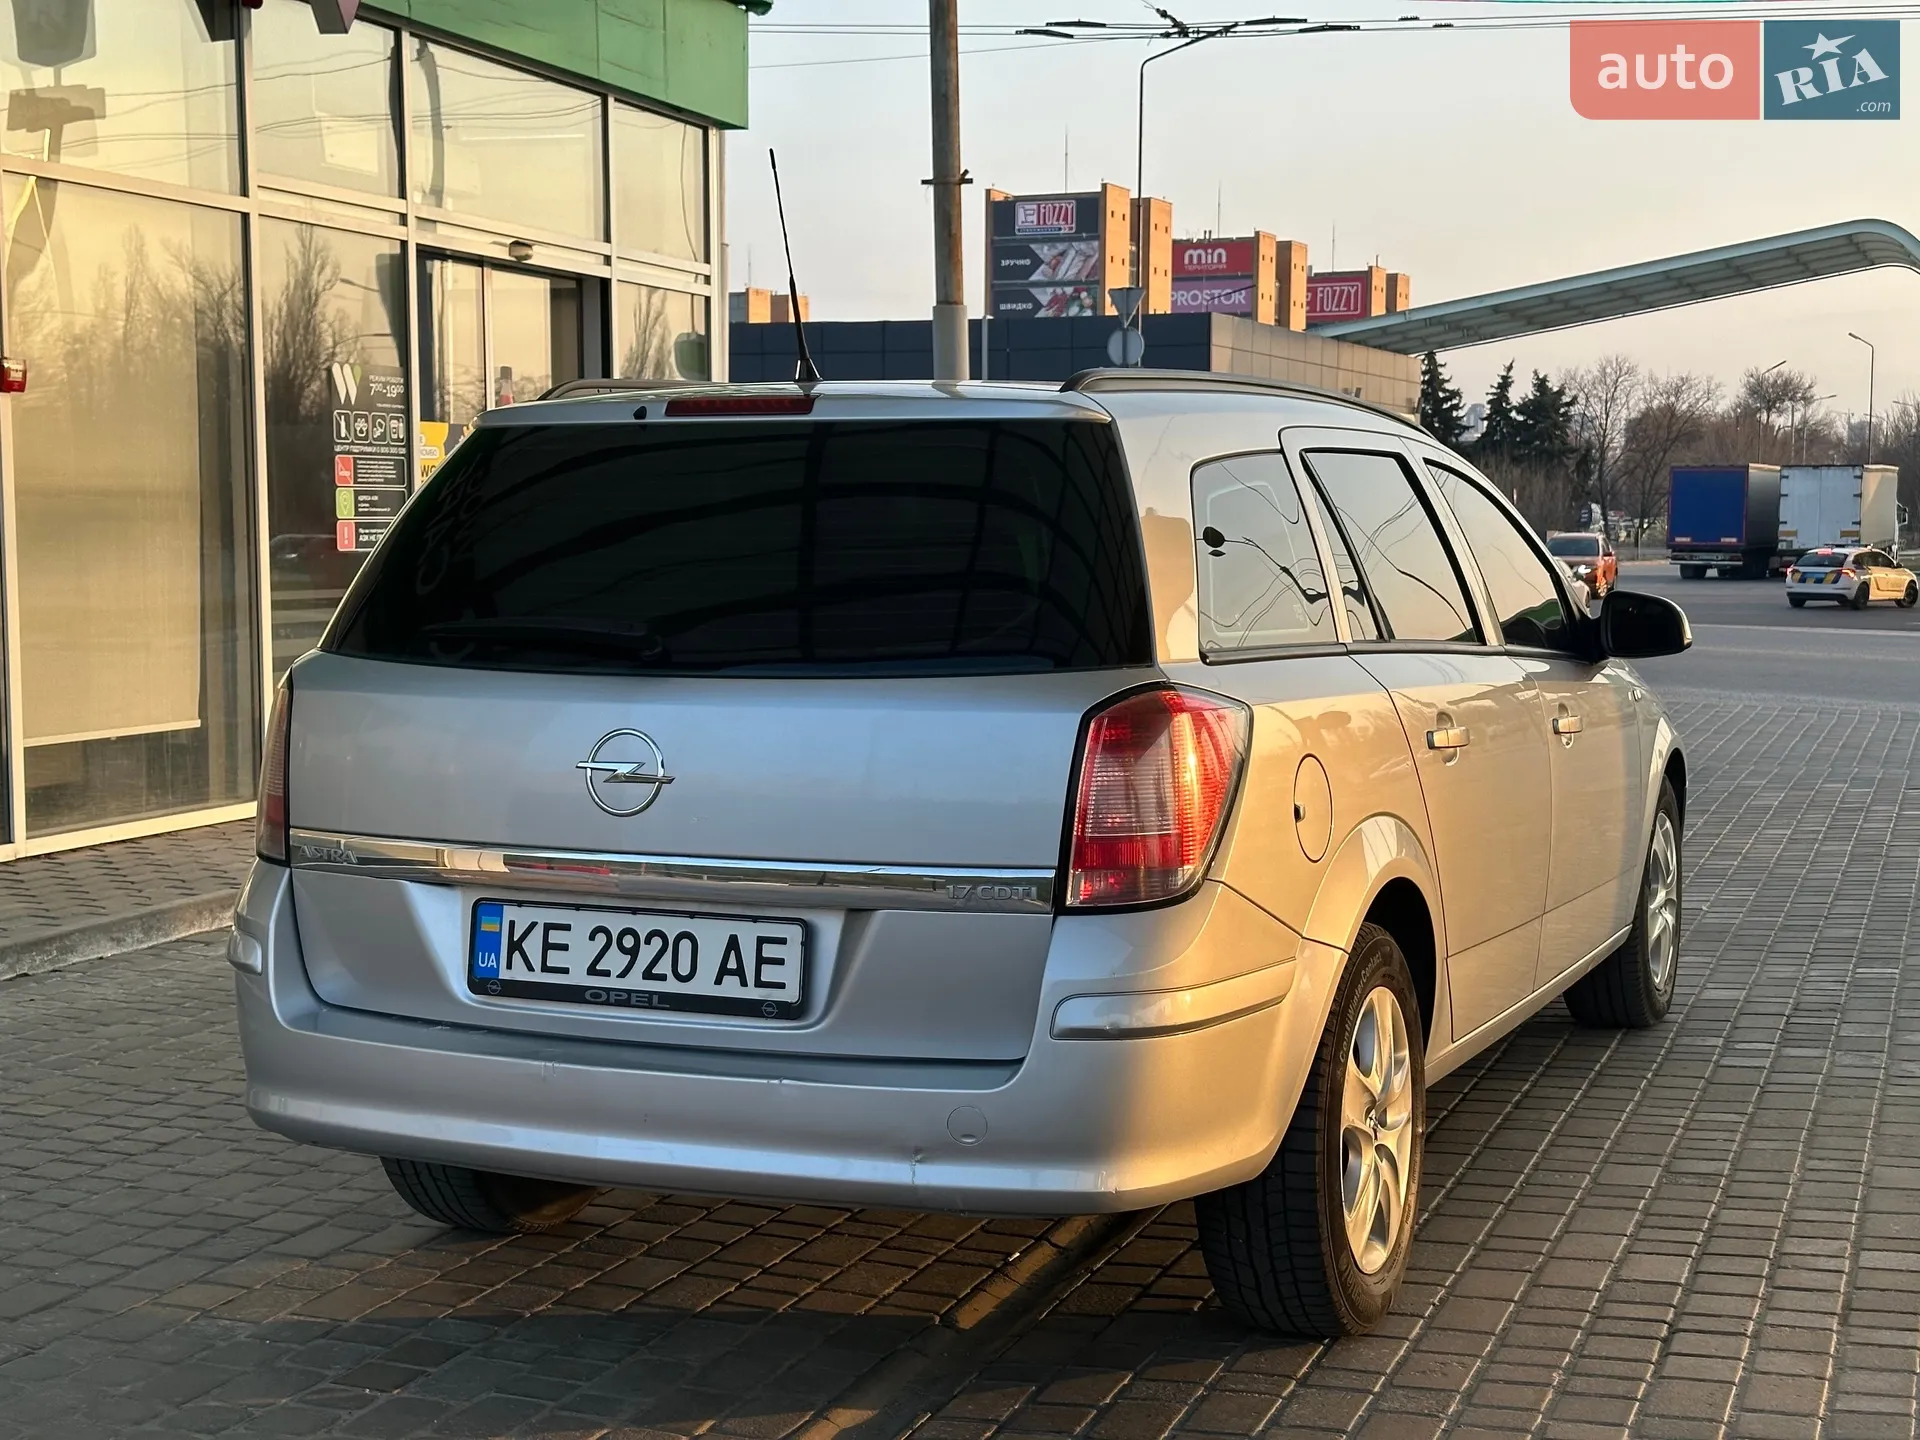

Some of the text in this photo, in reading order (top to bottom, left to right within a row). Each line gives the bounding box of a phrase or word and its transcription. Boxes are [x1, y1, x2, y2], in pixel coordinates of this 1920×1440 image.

[1040, 203, 1074, 225] FOZZY
[1184, 248, 1227, 265] min
[1316, 286, 1357, 312] FOZZY
[298, 845, 359, 864] ASTRA
[976, 885, 1037, 901] CDTI
[478, 951, 498, 969] UA
[505, 919, 788, 989] KE 2920 AE
[584, 989, 670, 1009] OPEL
